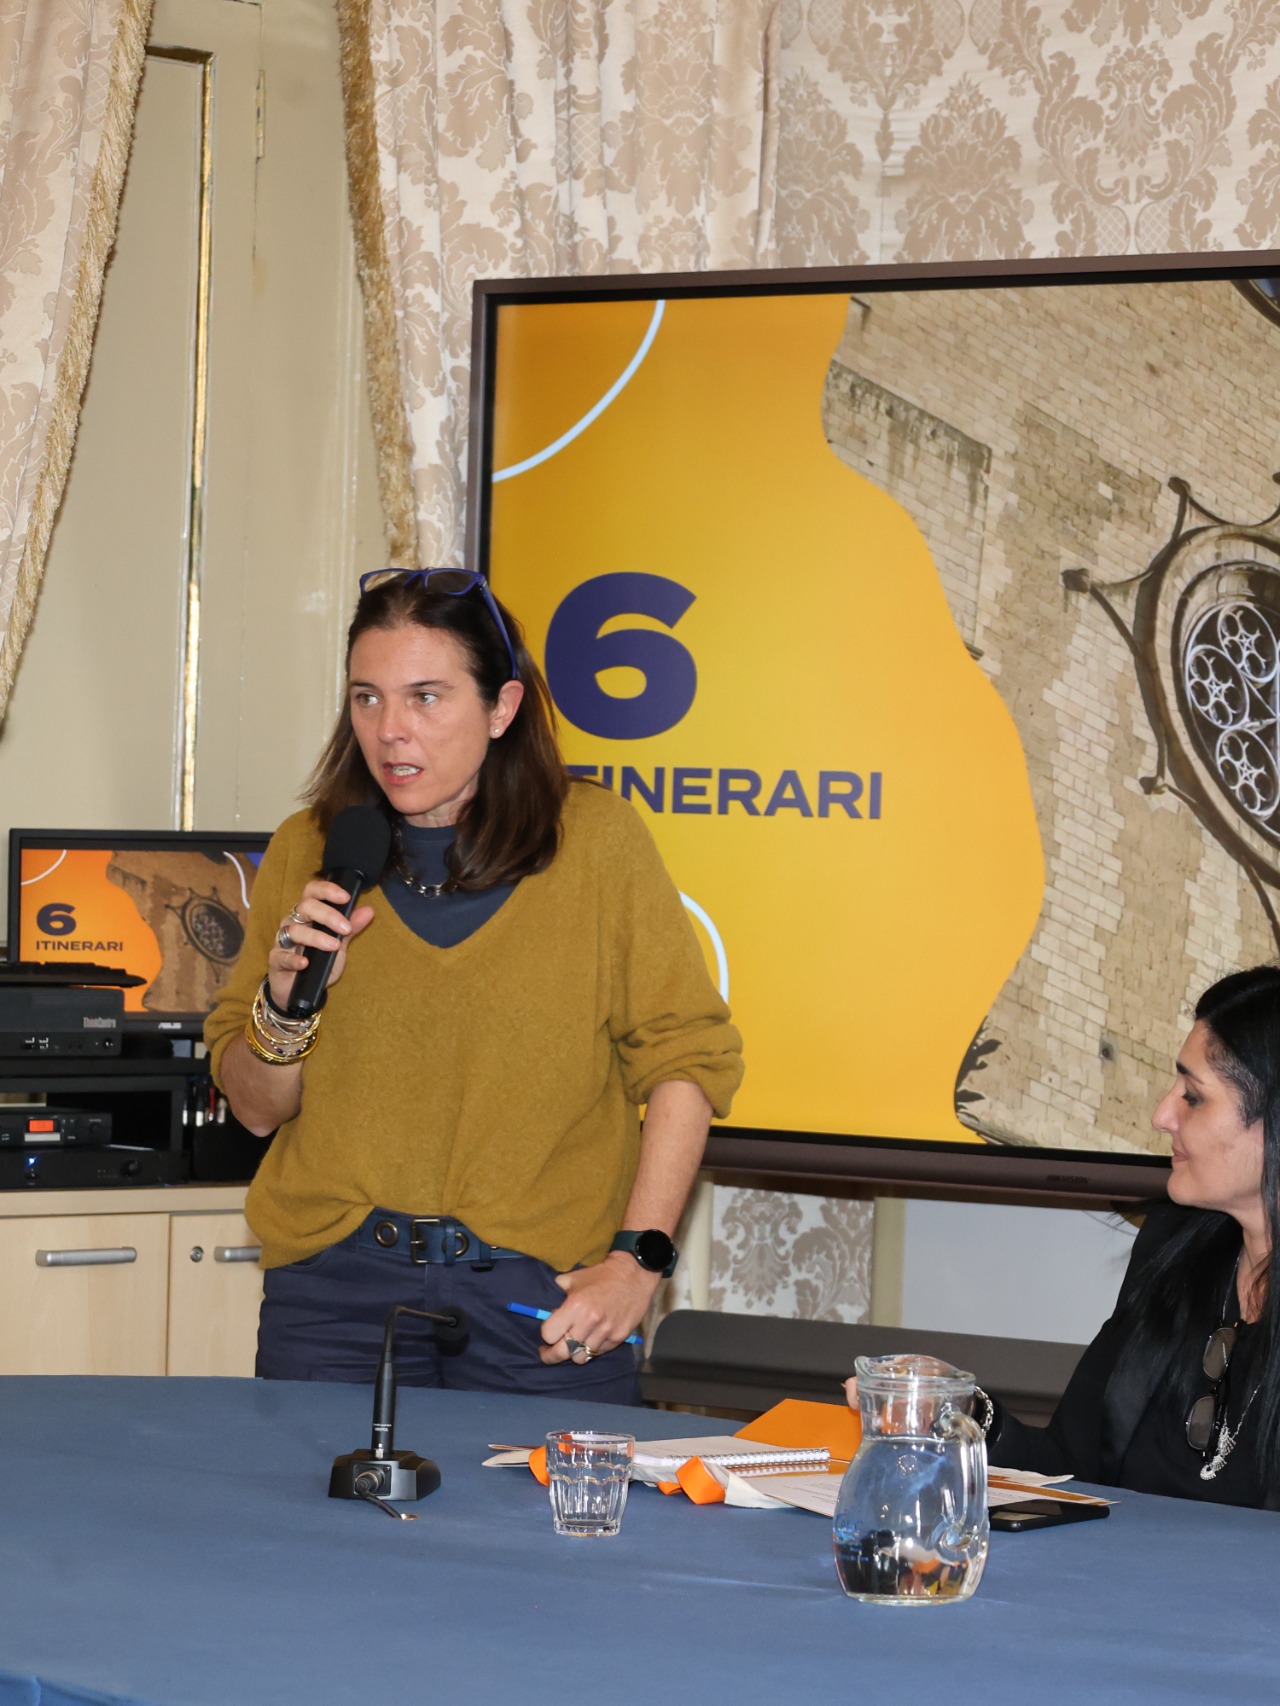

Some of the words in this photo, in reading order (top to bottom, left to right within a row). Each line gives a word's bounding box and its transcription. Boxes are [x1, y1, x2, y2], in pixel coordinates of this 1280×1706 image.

[544, 571, 698, 740] 6
[566, 764, 883, 820] NERARI
[36, 902, 77, 937] 6
[36, 940, 124, 951] ITINERARI
